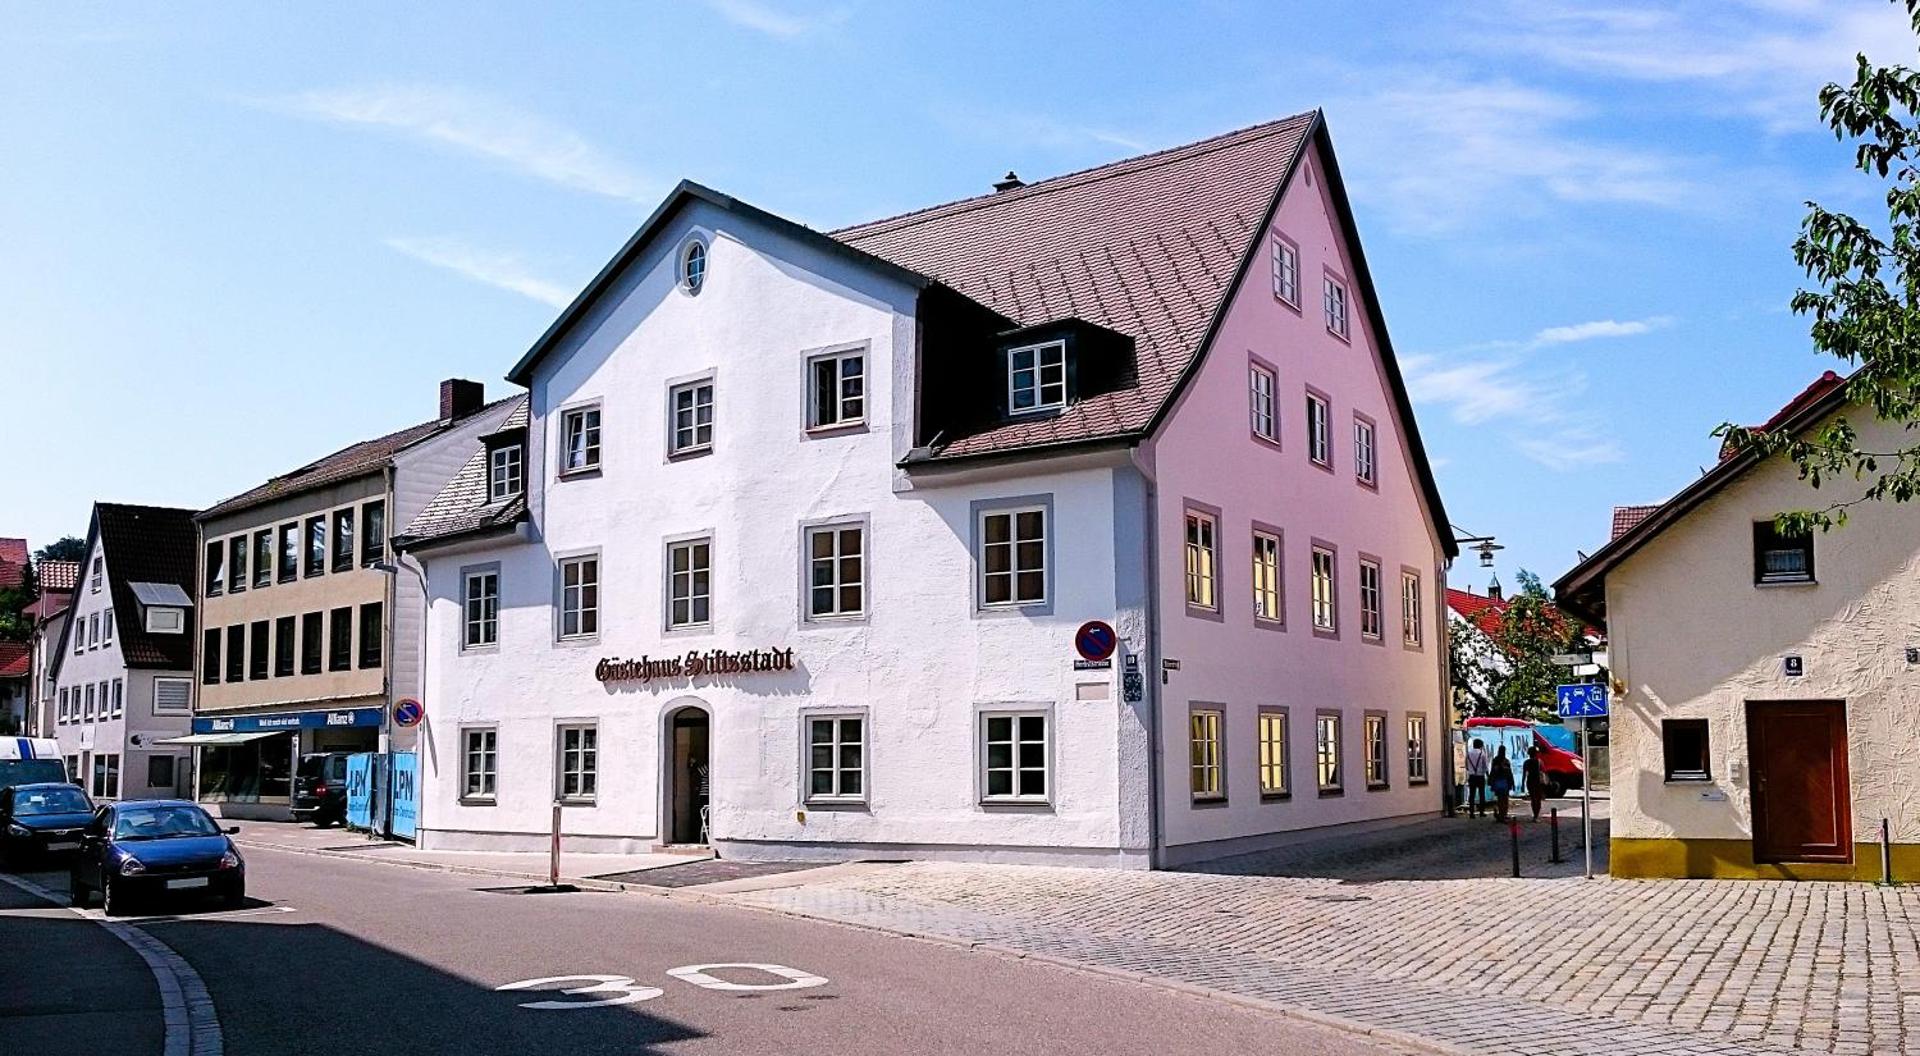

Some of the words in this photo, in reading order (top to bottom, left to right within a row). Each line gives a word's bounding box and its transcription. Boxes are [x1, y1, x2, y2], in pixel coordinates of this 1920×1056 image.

[595, 655, 681, 683] Gästehaus
[684, 646, 795, 677] Stiftsstadt
[1790, 658, 1797, 668] 8
[212, 719, 230, 730] Allianz
[327, 713, 348, 725] Allianz
[495, 963, 829, 1010] 30
